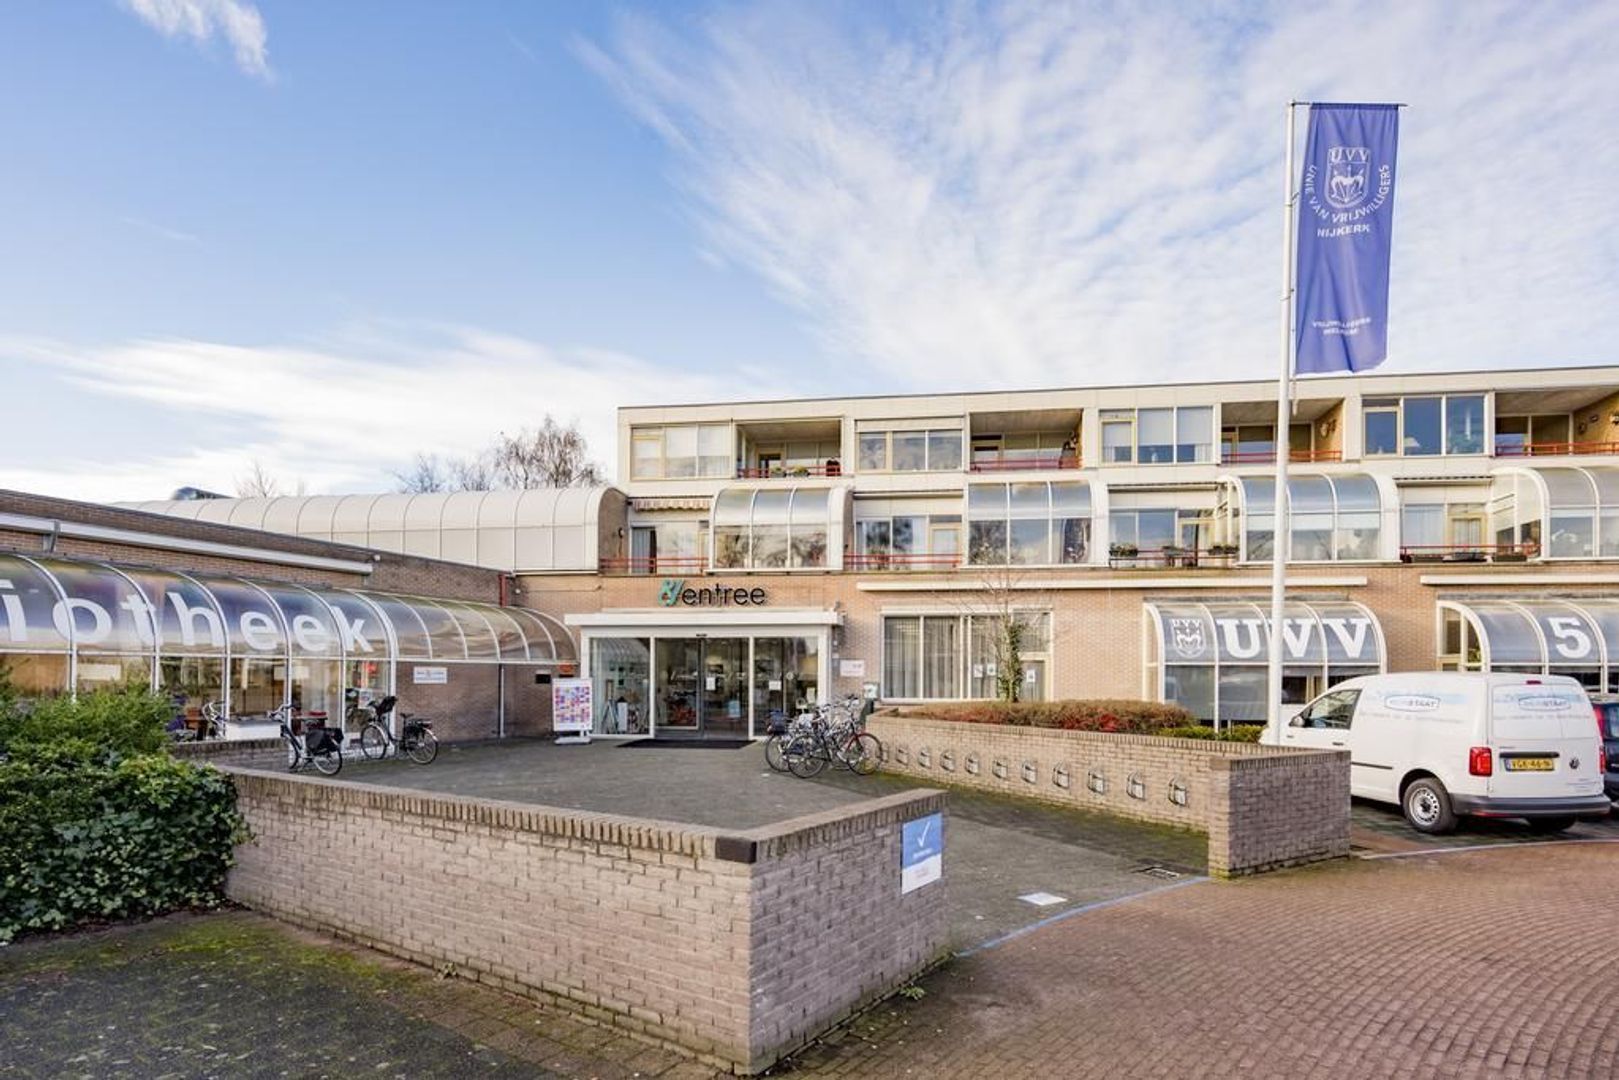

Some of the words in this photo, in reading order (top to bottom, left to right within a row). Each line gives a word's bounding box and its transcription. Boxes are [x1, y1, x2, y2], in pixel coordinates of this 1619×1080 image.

[1330, 147, 1369, 163] UVV
[1304, 164, 1317, 195] UNIE
[1309, 196, 1330, 220] VAN
[1317, 223, 1371, 238] NIJKERK
[681, 583, 766, 606] entree
[1215, 618, 1372, 659] UVV
[1547, 616, 1591, 659] 5
